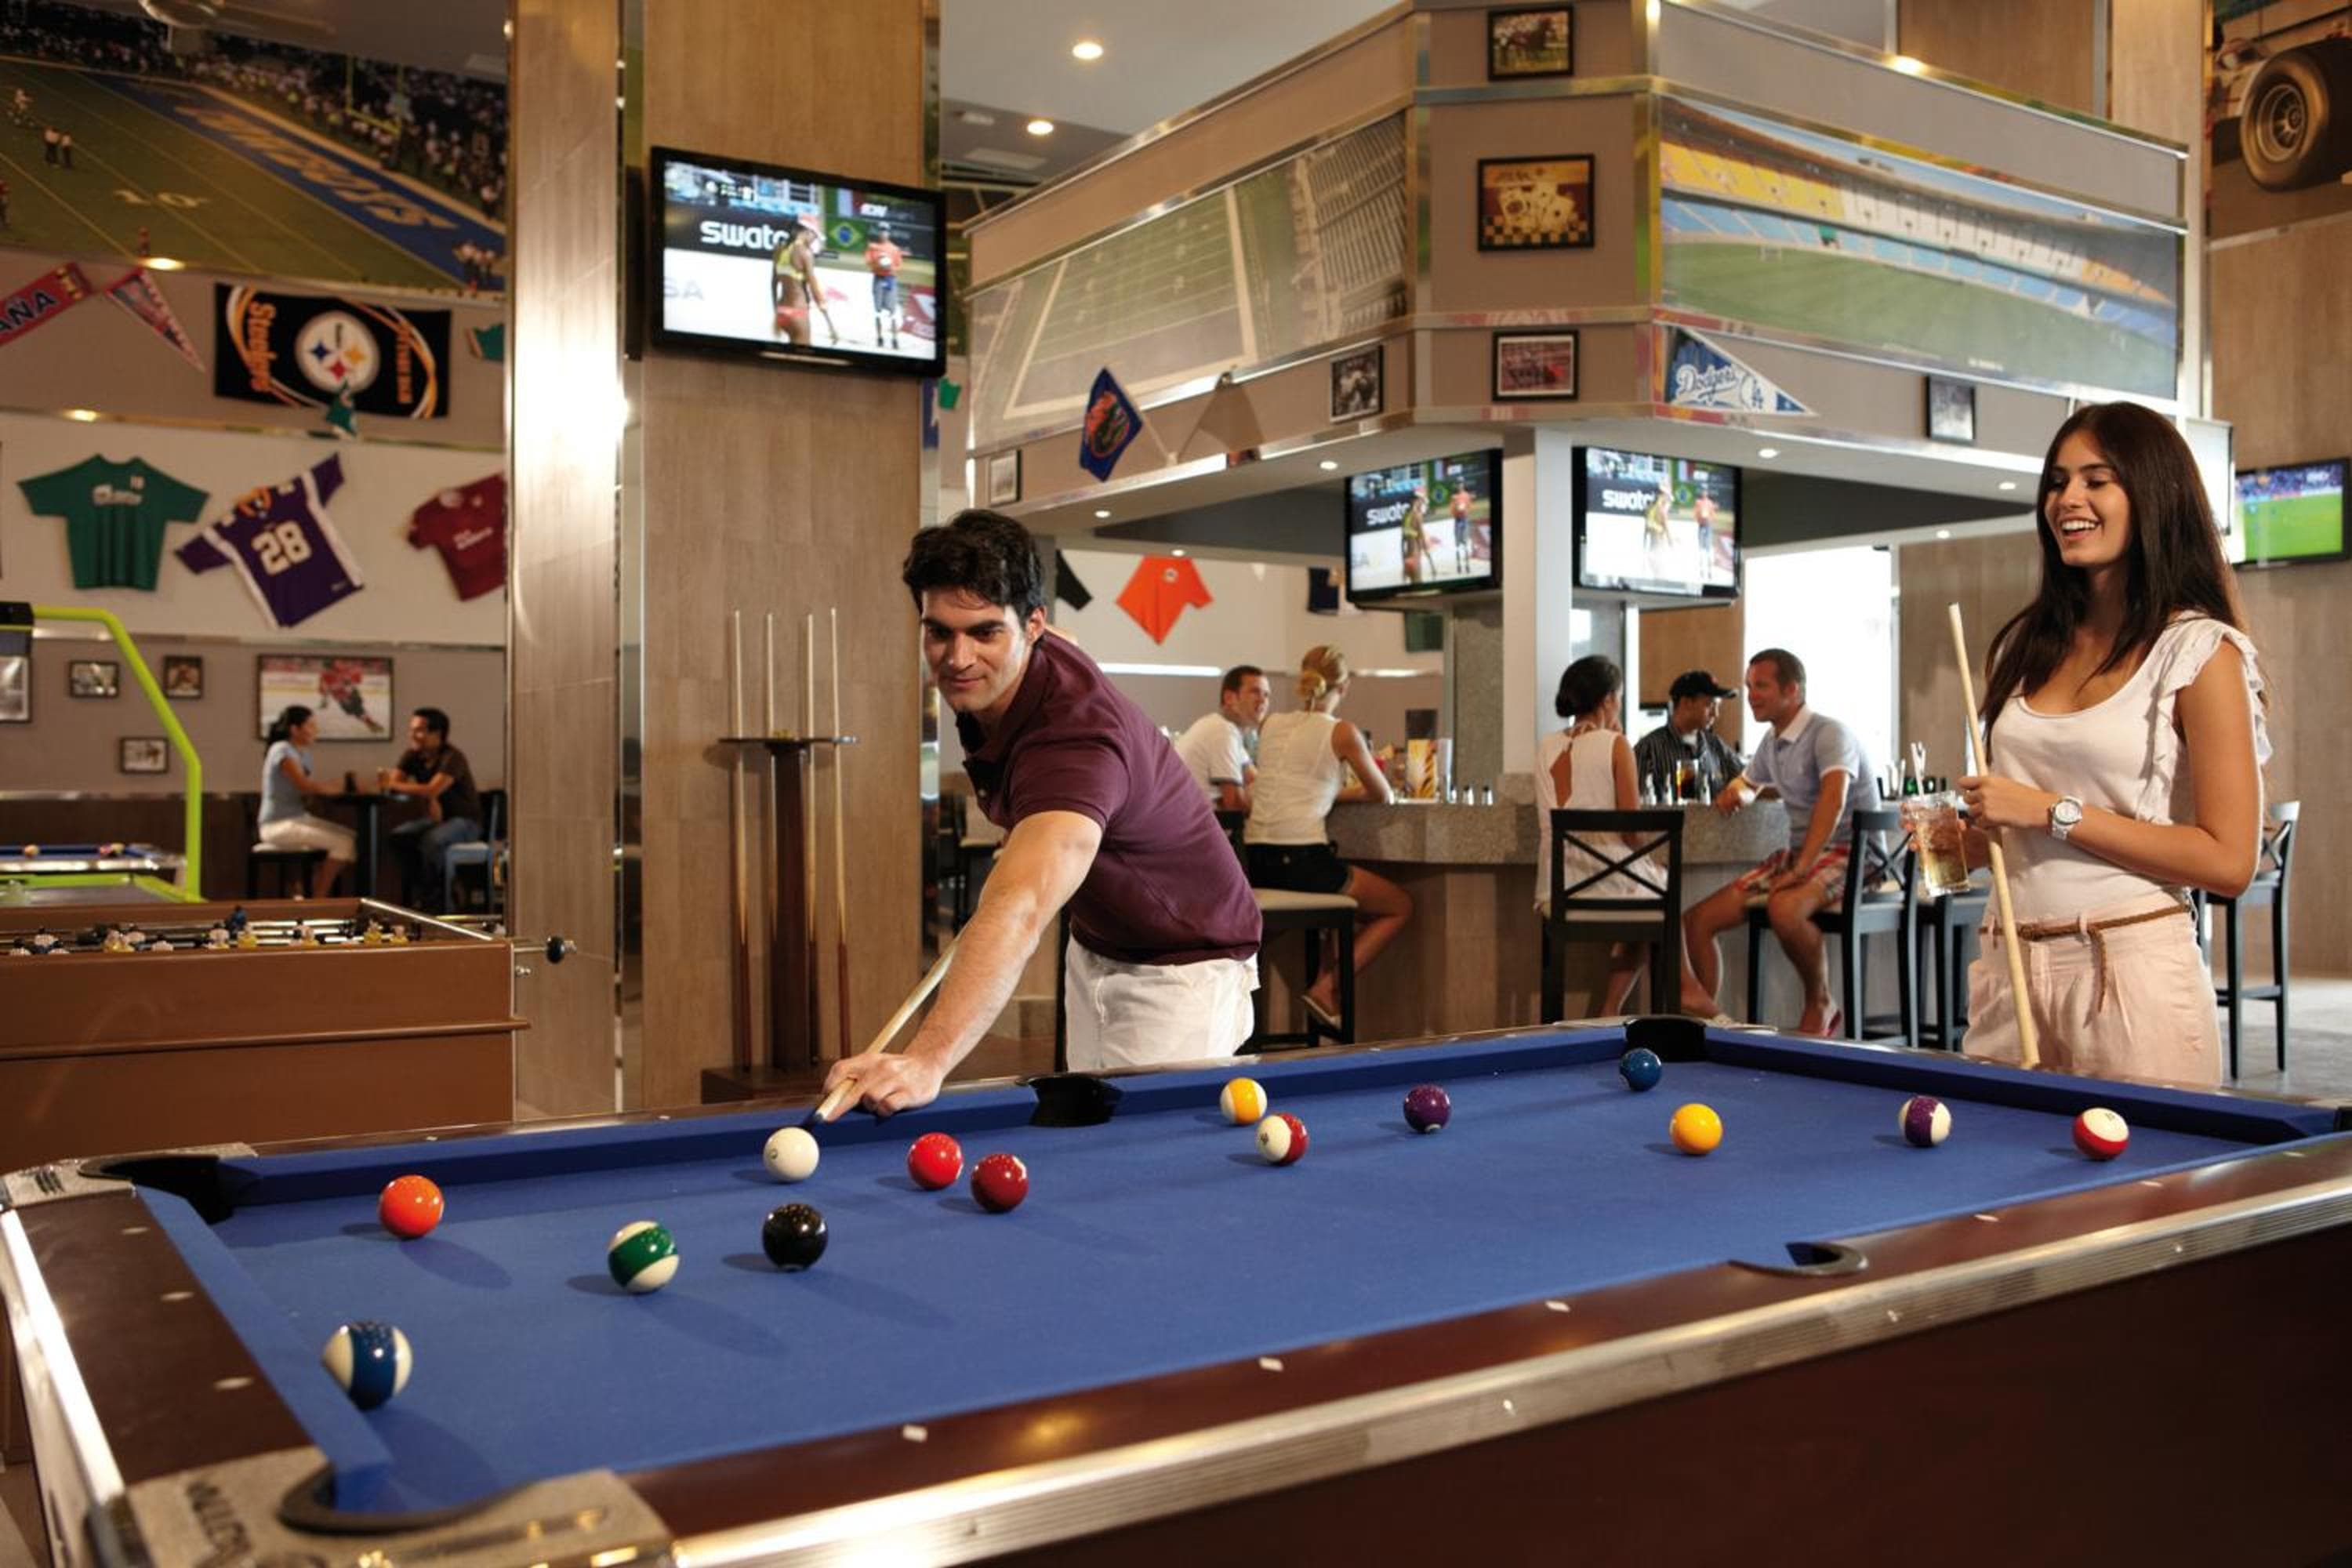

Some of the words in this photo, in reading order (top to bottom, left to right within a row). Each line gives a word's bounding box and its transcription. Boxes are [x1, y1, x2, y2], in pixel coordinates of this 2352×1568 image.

[700, 221, 790, 250] swatc
[1602, 489, 1655, 511] swatc
[1367, 502, 1410, 526] swatc
[251, 520, 312, 576] 28
